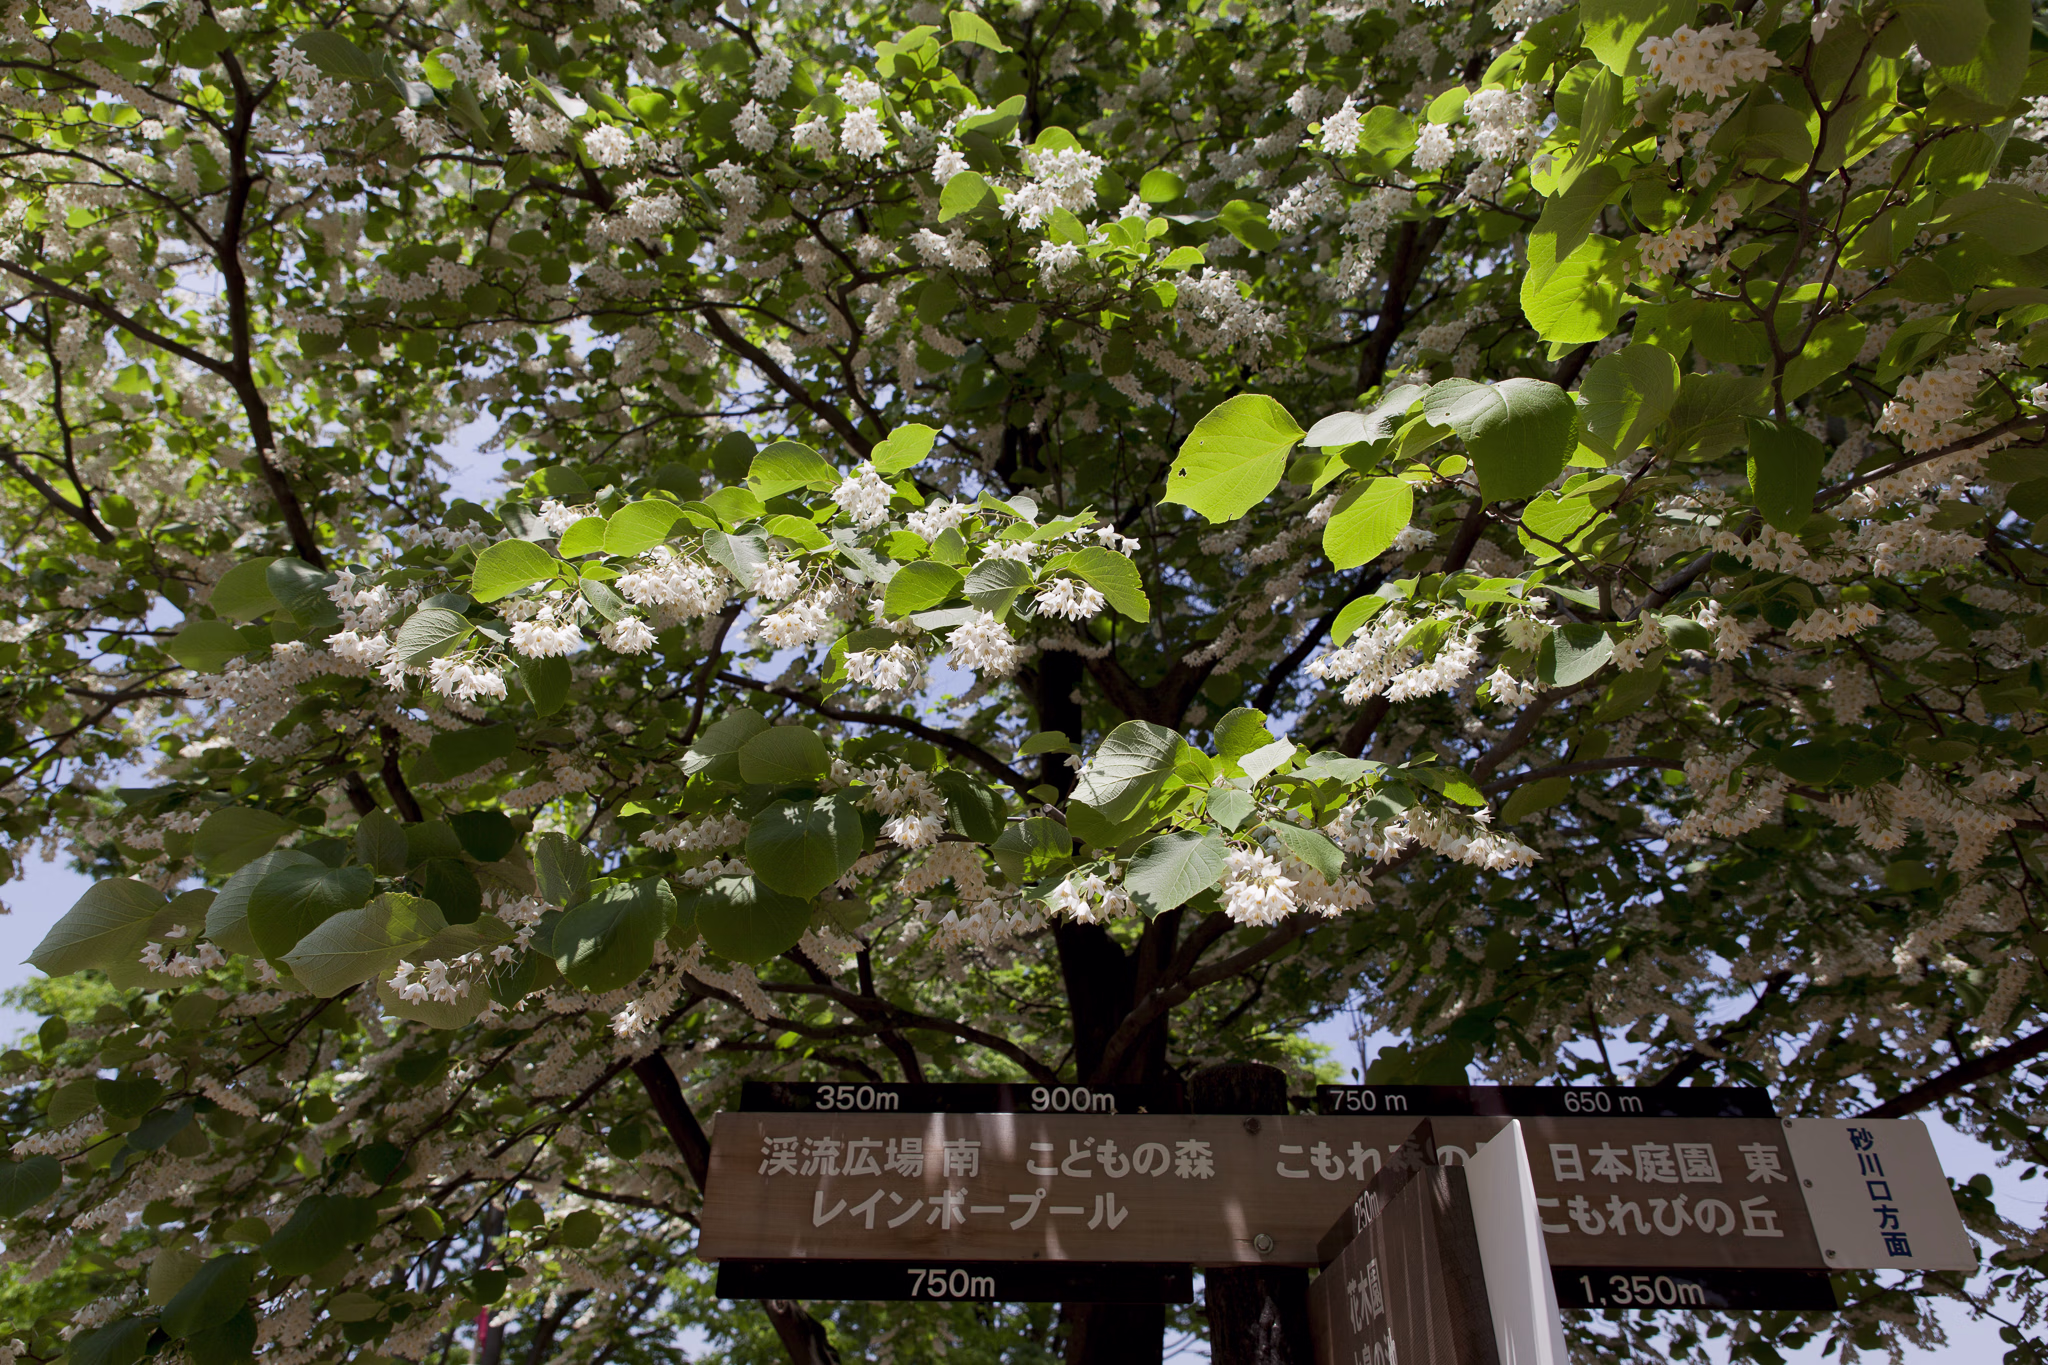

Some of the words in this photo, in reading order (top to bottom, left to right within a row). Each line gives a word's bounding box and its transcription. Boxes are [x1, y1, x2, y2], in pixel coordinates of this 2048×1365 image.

[815, 1085, 899, 1110] 350m
[1030, 1086, 1116, 1112] 900m
[1329, 1090, 1377, 1111] 750
[1384, 1094, 1408, 1111] m
[1564, 1091, 1612, 1113] 650
[1619, 1096, 1643, 1113] m
[757, 1136, 925, 1177] 渓流広場
[942, 1138, 982, 1177] 南
[1026, 1136, 1216, 1180] こどもの森
[1549, 1141, 1723, 1184] 日本庭園
[1738, 1142, 1788, 1184] 東
[812, 1187, 1128, 1231] レインボープール
[1354, 1189, 1380, 1235] 250m
[1846, 1126, 1912, 1258] 砂川口方面
[1536, 1193, 1785, 1238] こもれびの丘
[907, 1268, 996, 1298] 750m
[1346, 1257, 1385, 1335] 花木園
[1579, 1275, 1707, 1307] 1,350m
